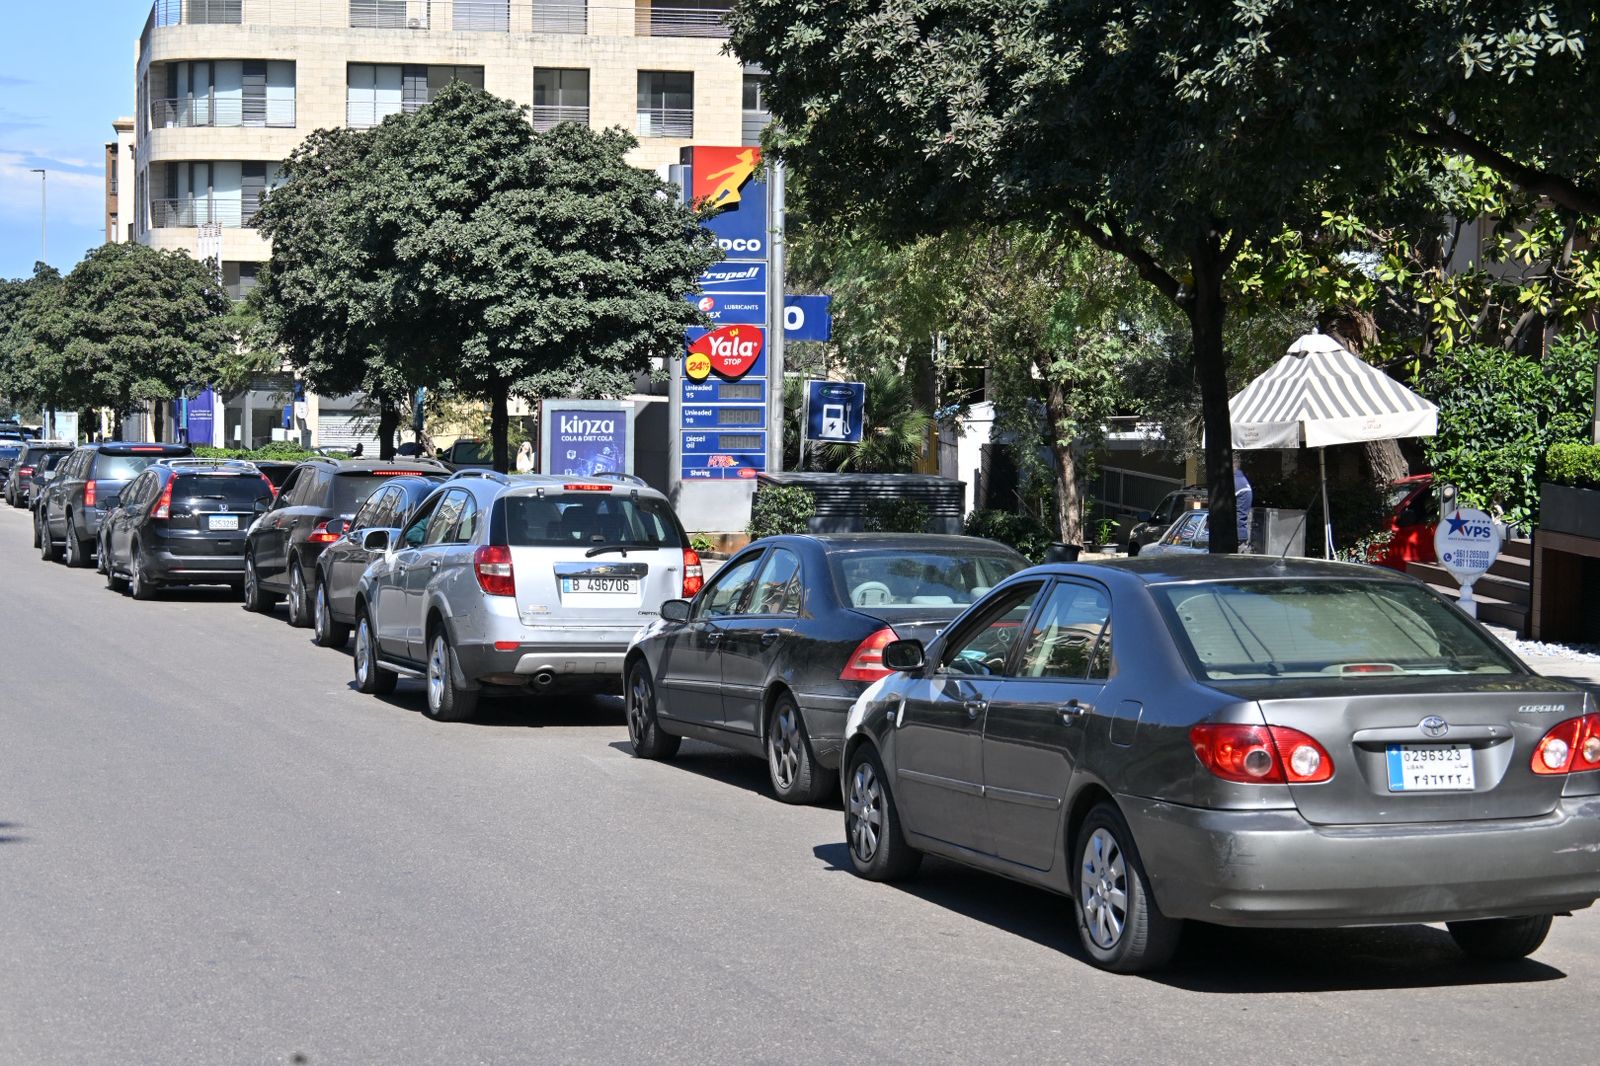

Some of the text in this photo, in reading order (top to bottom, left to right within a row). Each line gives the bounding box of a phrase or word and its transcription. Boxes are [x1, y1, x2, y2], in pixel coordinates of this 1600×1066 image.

[708, 336, 754, 357] Yala
[723, 358, 742, 366] STOP
[560, 415, 615, 436] kinza
[1463, 525, 1491, 538] VPS
[572, 578, 630, 592] B 496706
[1518, 703, 1565, 713] COROLLA
